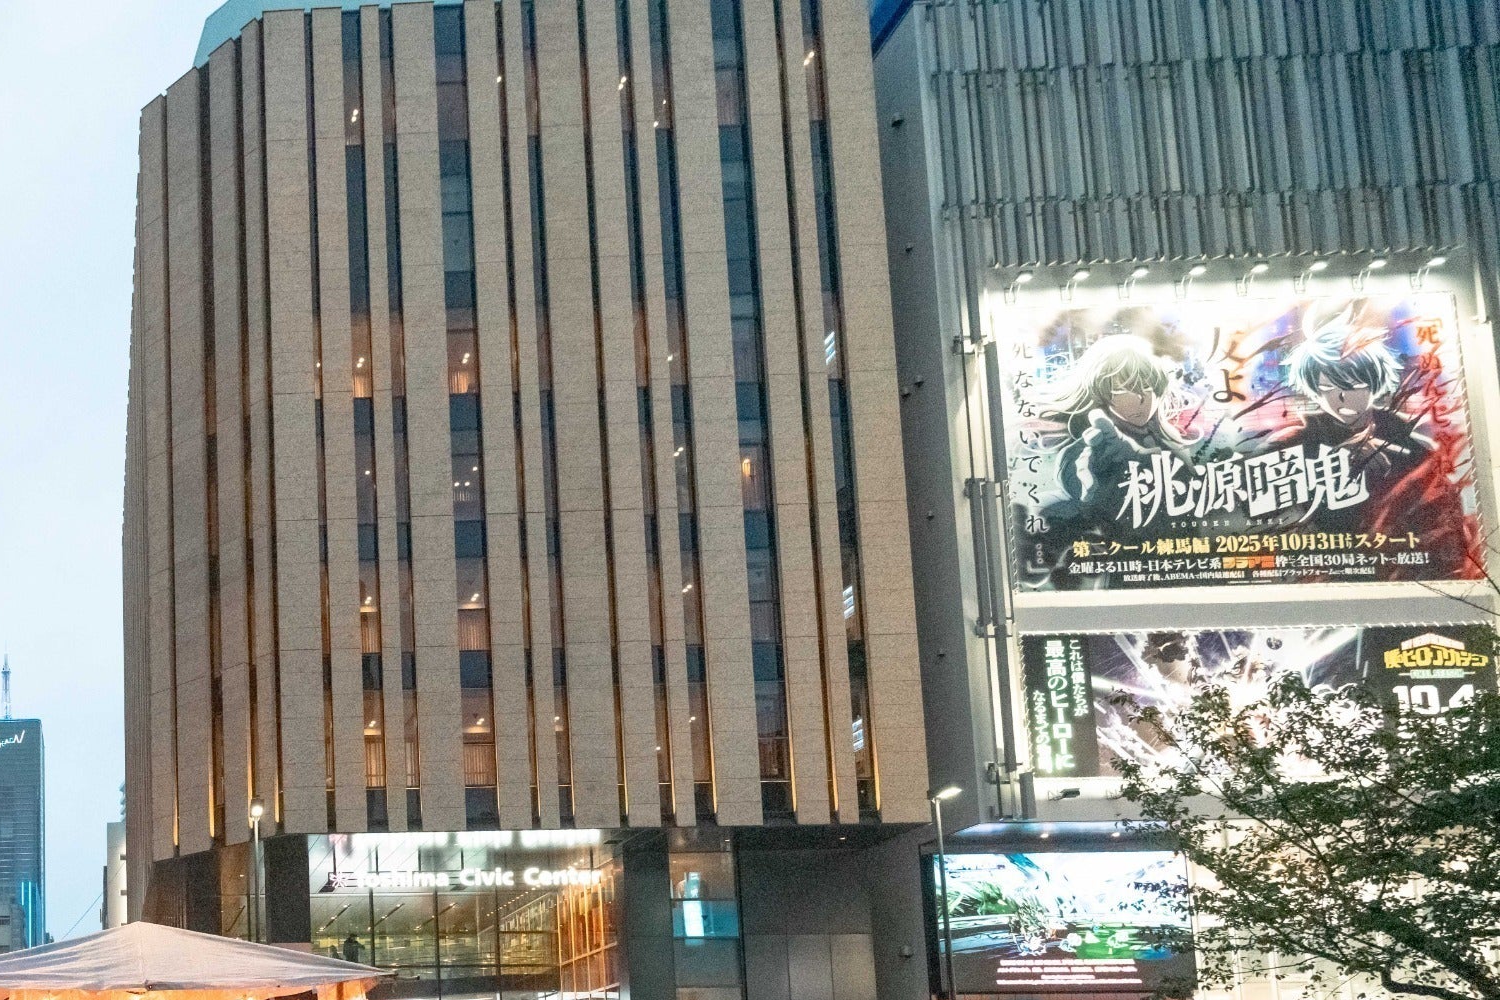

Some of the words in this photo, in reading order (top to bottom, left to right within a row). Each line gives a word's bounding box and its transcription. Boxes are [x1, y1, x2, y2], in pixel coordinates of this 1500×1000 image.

[1115, 444, 1370, 529] 桃源暗鬼
[1171, 520, 1231, 528] TOUGEN
[1045, 640, 1075, 769] 最高のヒーローに
[459, 867, 514, 886] Civic
[523, 867, 602, 886] Center
